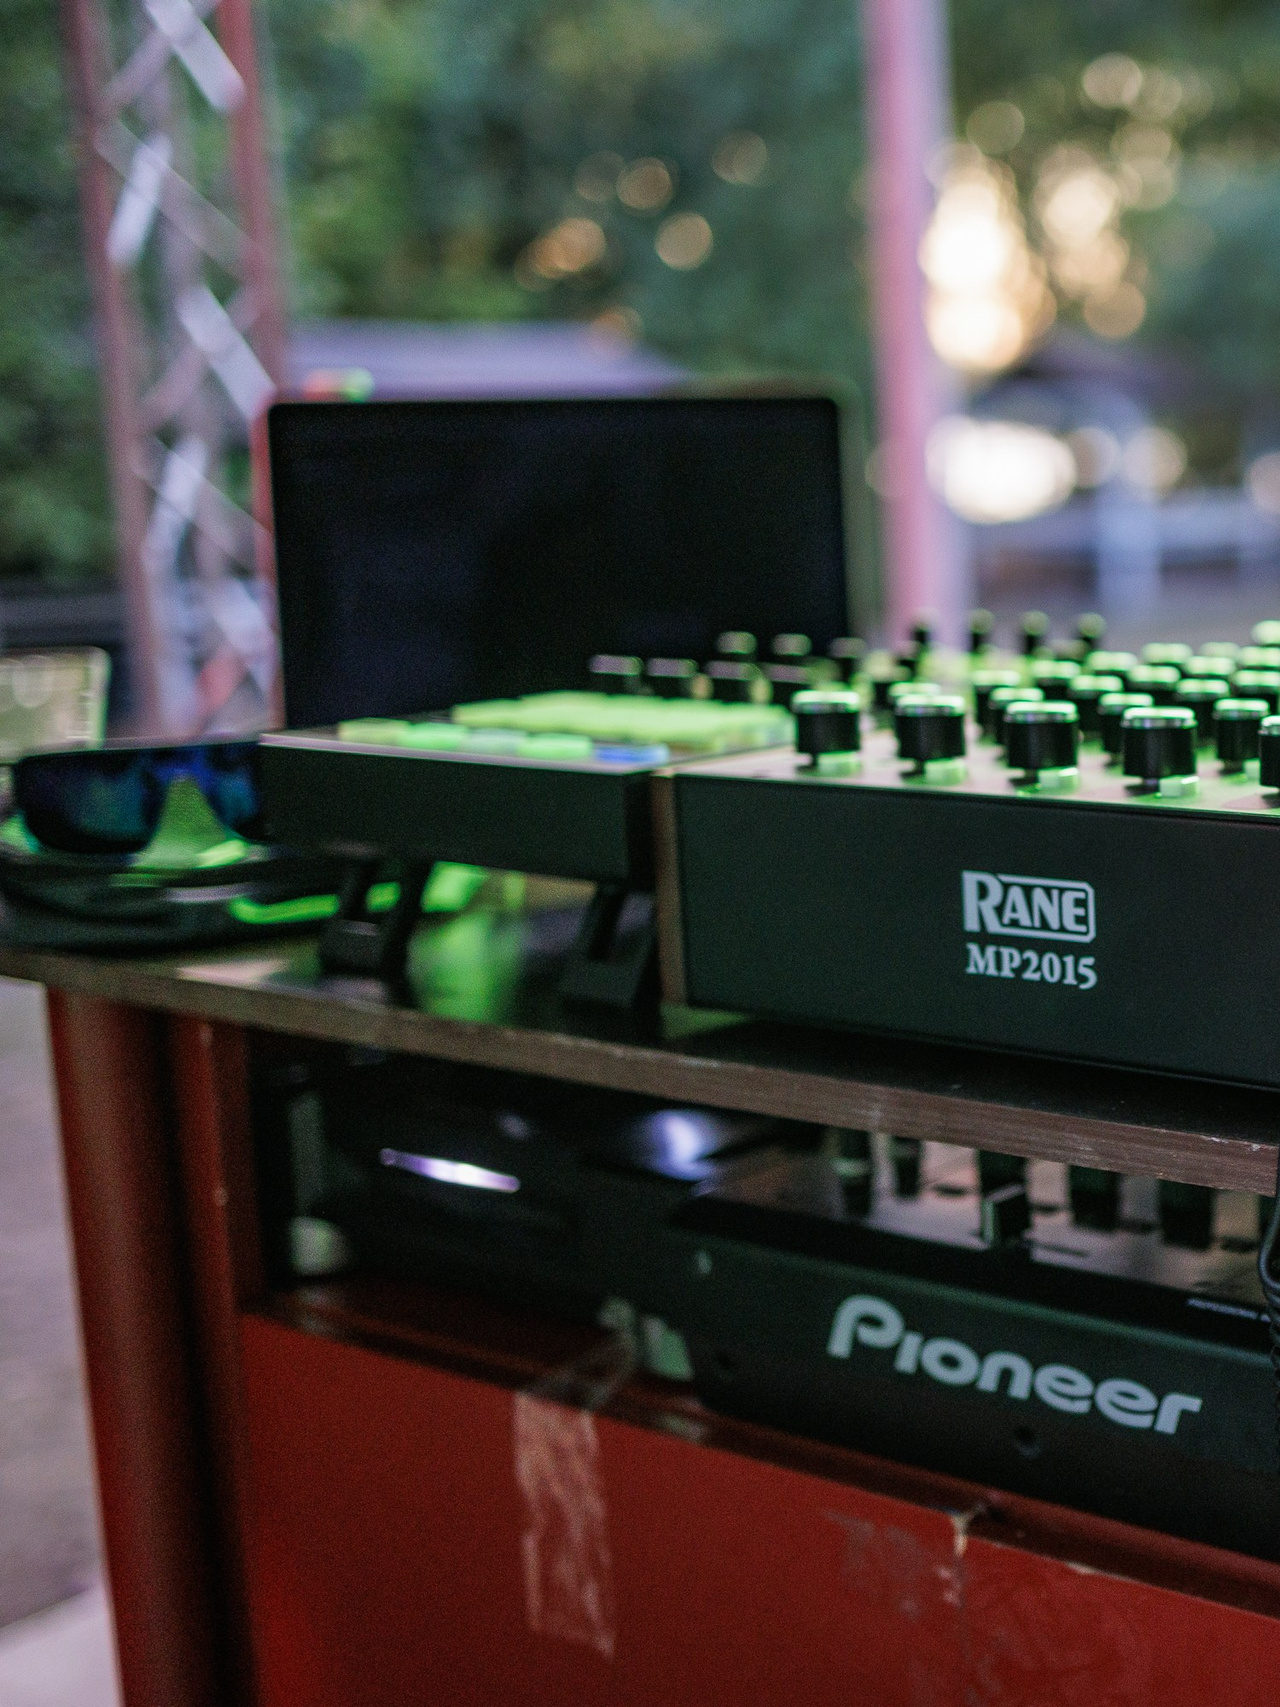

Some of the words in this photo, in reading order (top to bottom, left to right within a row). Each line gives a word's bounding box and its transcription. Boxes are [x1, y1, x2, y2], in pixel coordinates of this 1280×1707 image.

[962, 869, 1089, 934] RANE
[966, 942, 1098, 990] MP2015
[827, 1294, 1203, 1435] Pioneer
